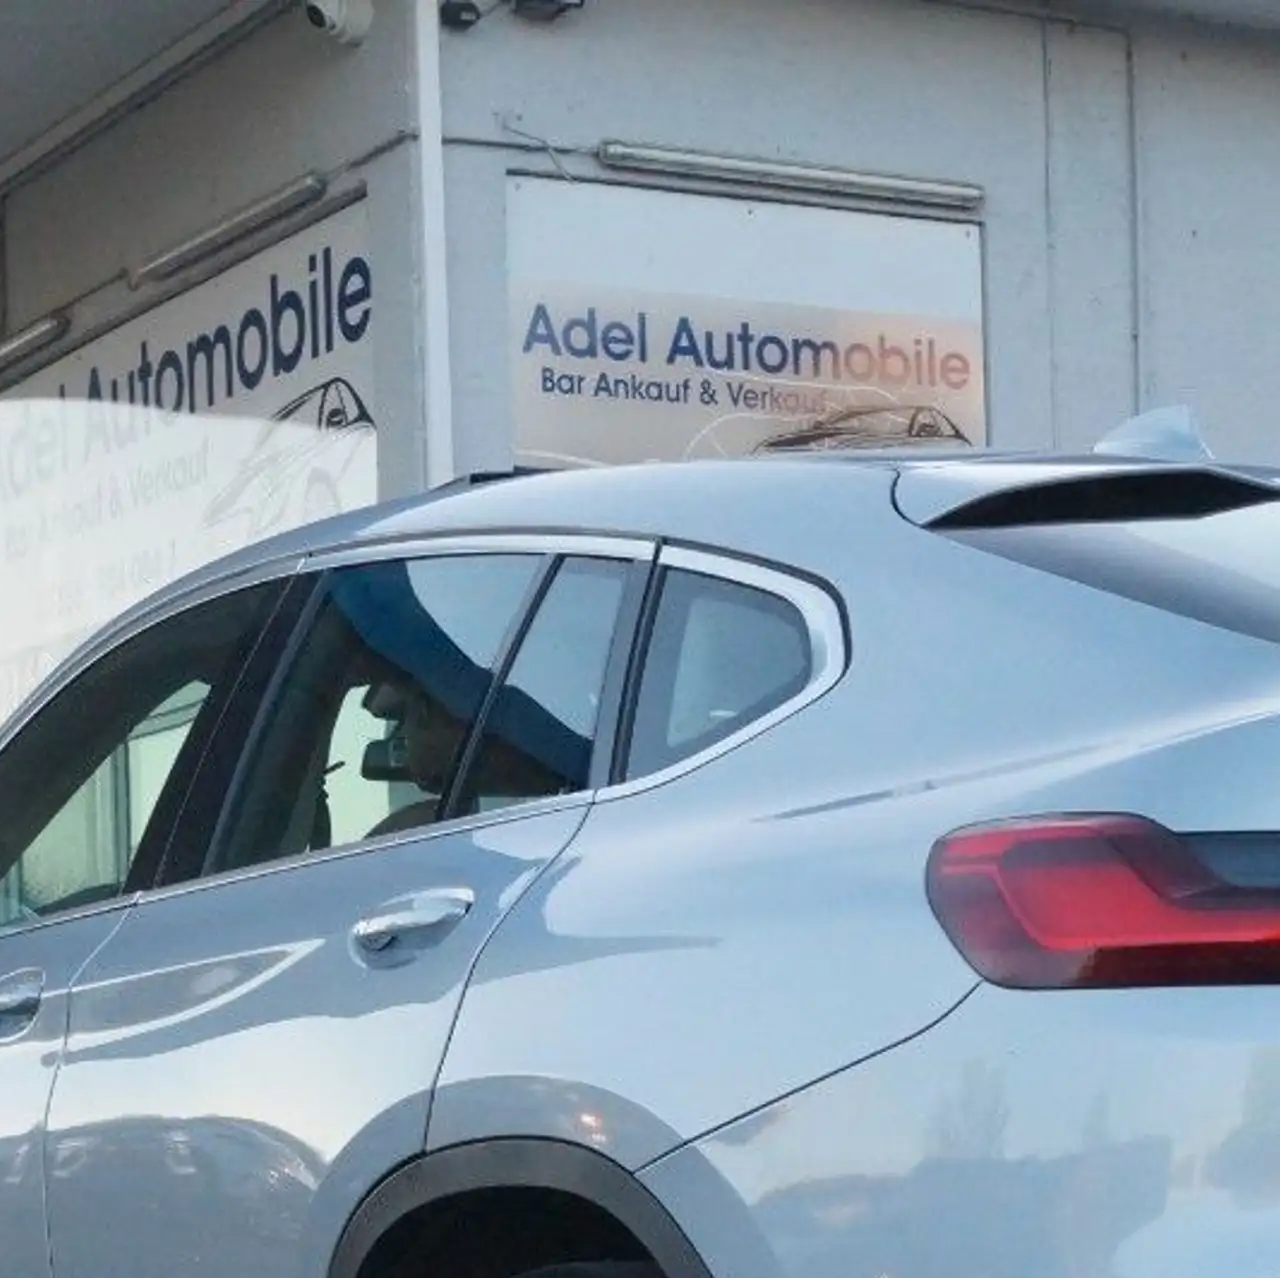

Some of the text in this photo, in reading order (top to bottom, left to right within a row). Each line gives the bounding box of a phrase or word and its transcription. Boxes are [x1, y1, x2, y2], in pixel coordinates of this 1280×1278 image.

[84, 246, 372, 462] Automobile
[522, 303, 970, 391] Adel Automobile
[541, 367, 586, 395] Bar
[594, 373, 691, 404] Ankauf
[699, 380, 718, 405] &
